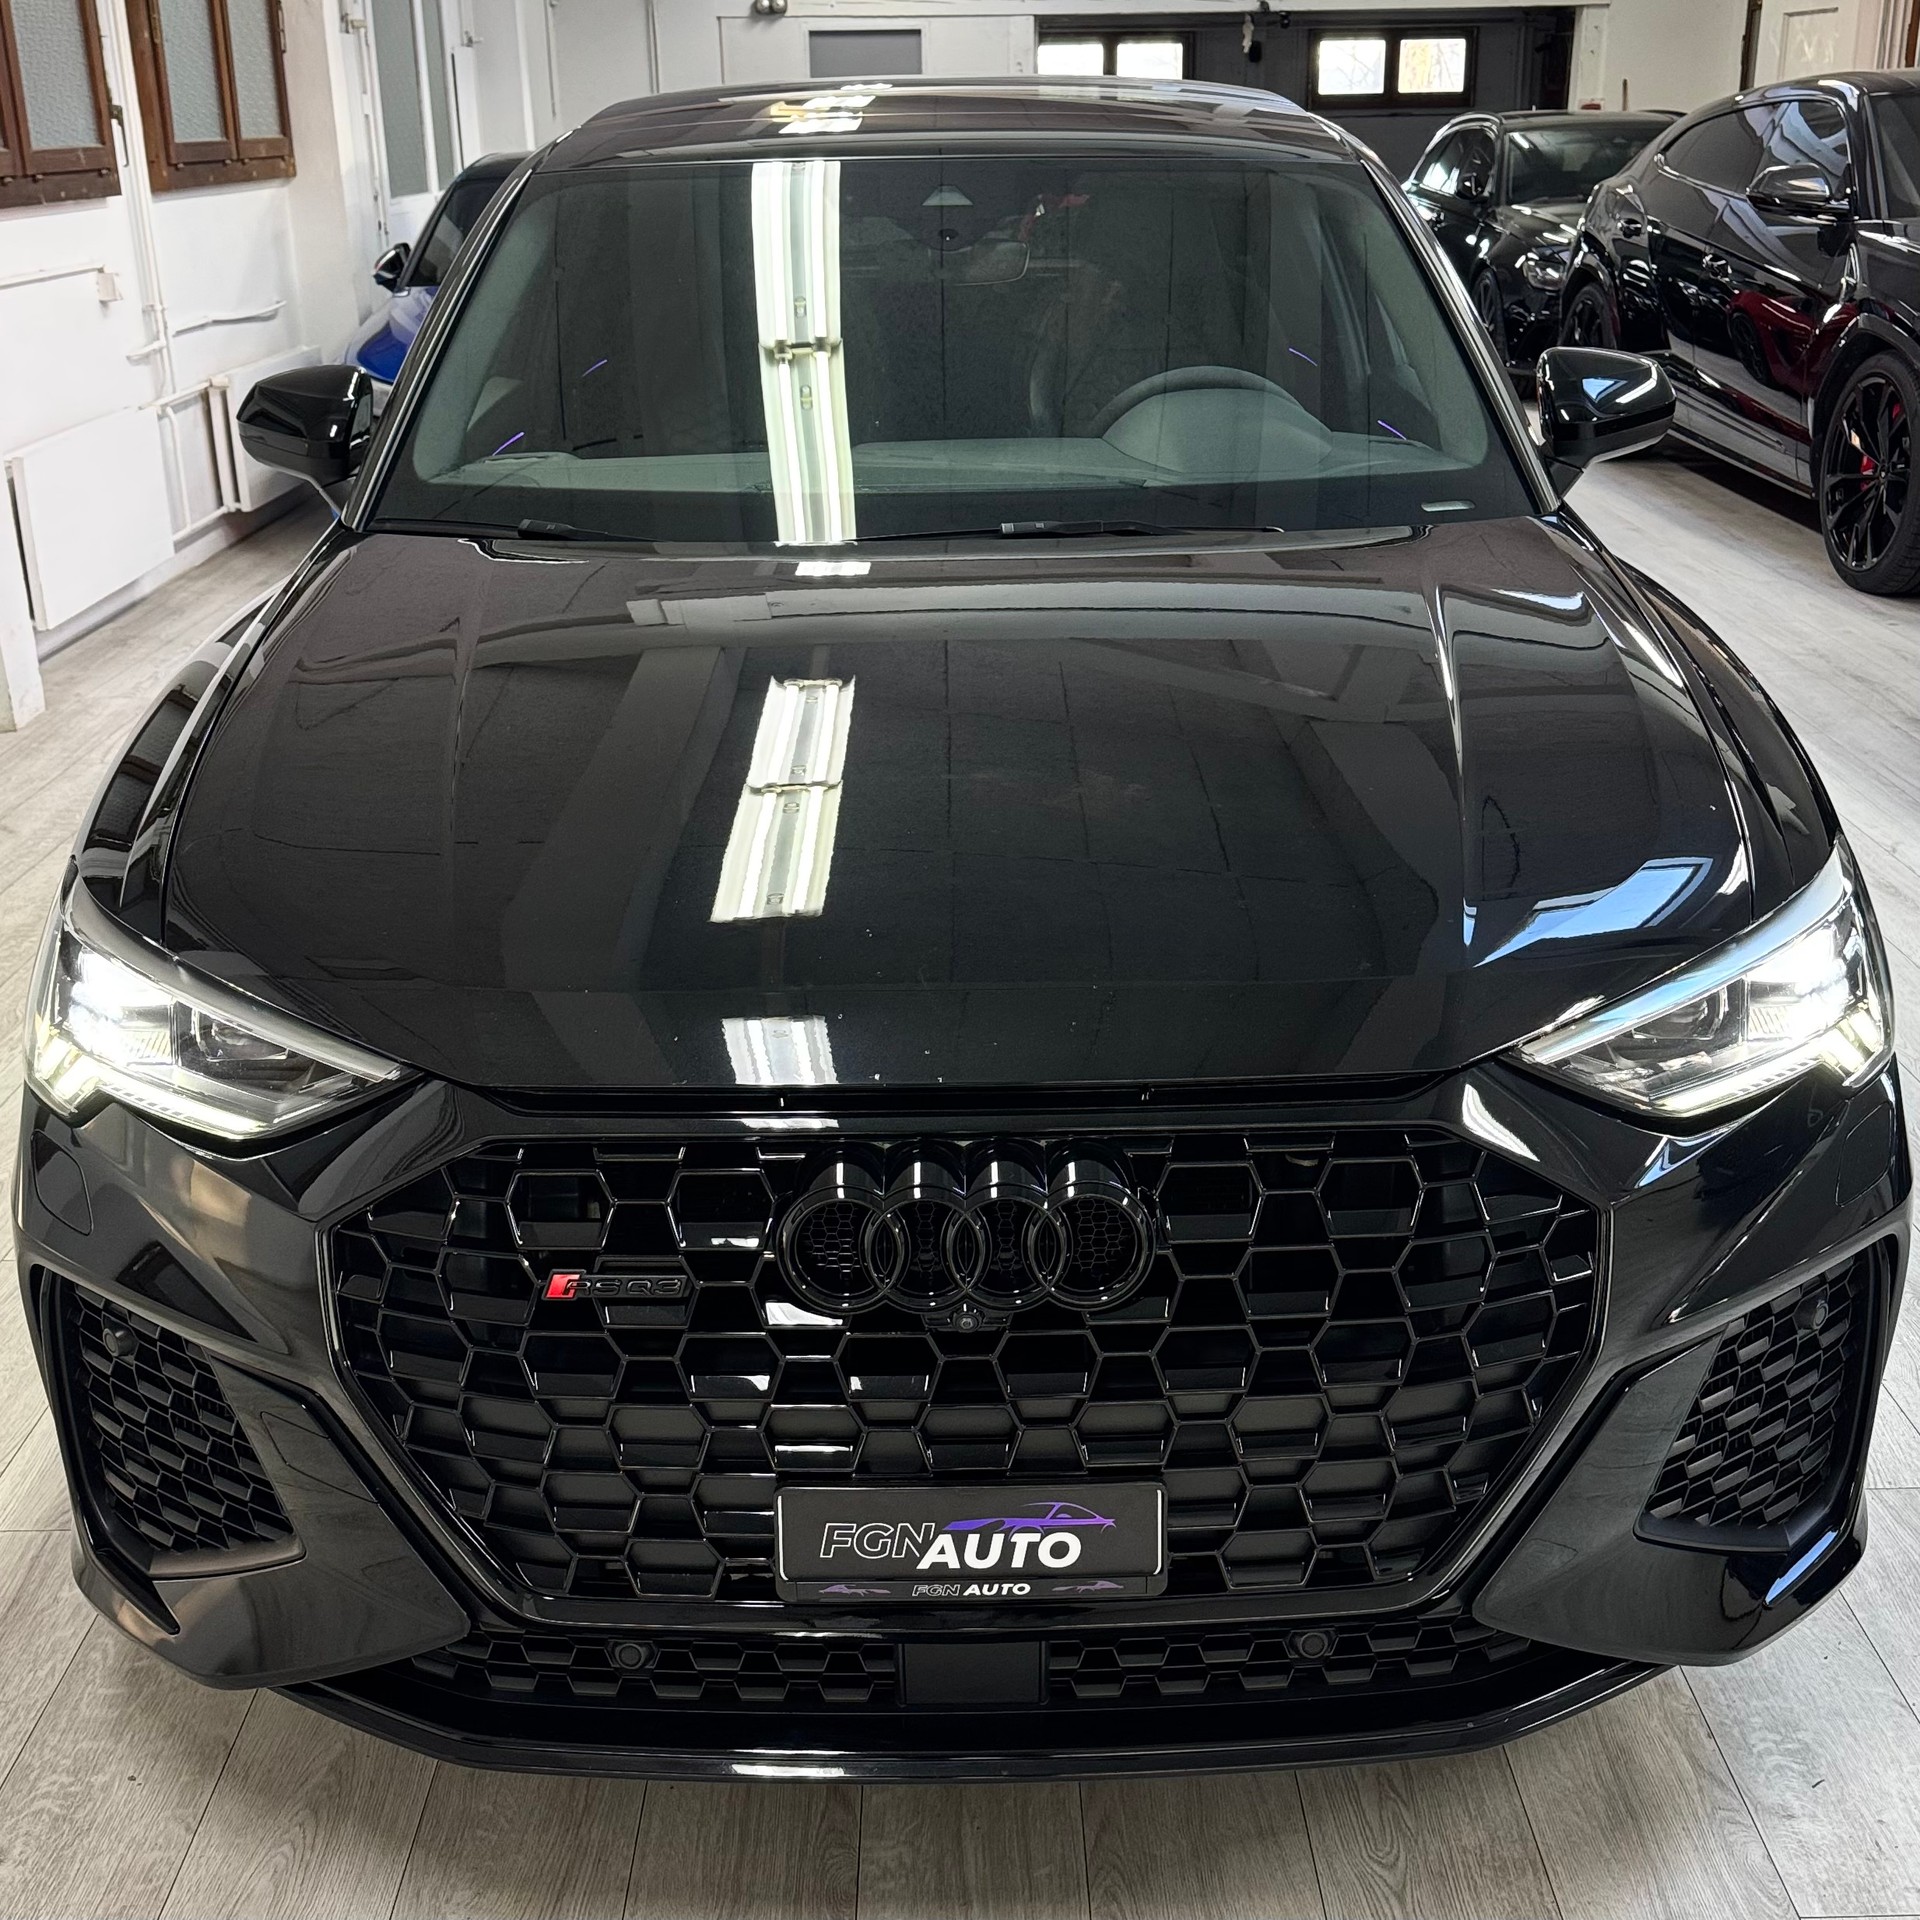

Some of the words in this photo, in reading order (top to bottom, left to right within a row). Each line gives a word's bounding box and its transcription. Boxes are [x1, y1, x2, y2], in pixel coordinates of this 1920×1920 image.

[819, 1522, 936, 1559] FGN
[916, 1531, 1082, 1570] AUTO
[912, 1584, 961, 1597] FGN
[962, 1583, 1032, 1596] AUTO
